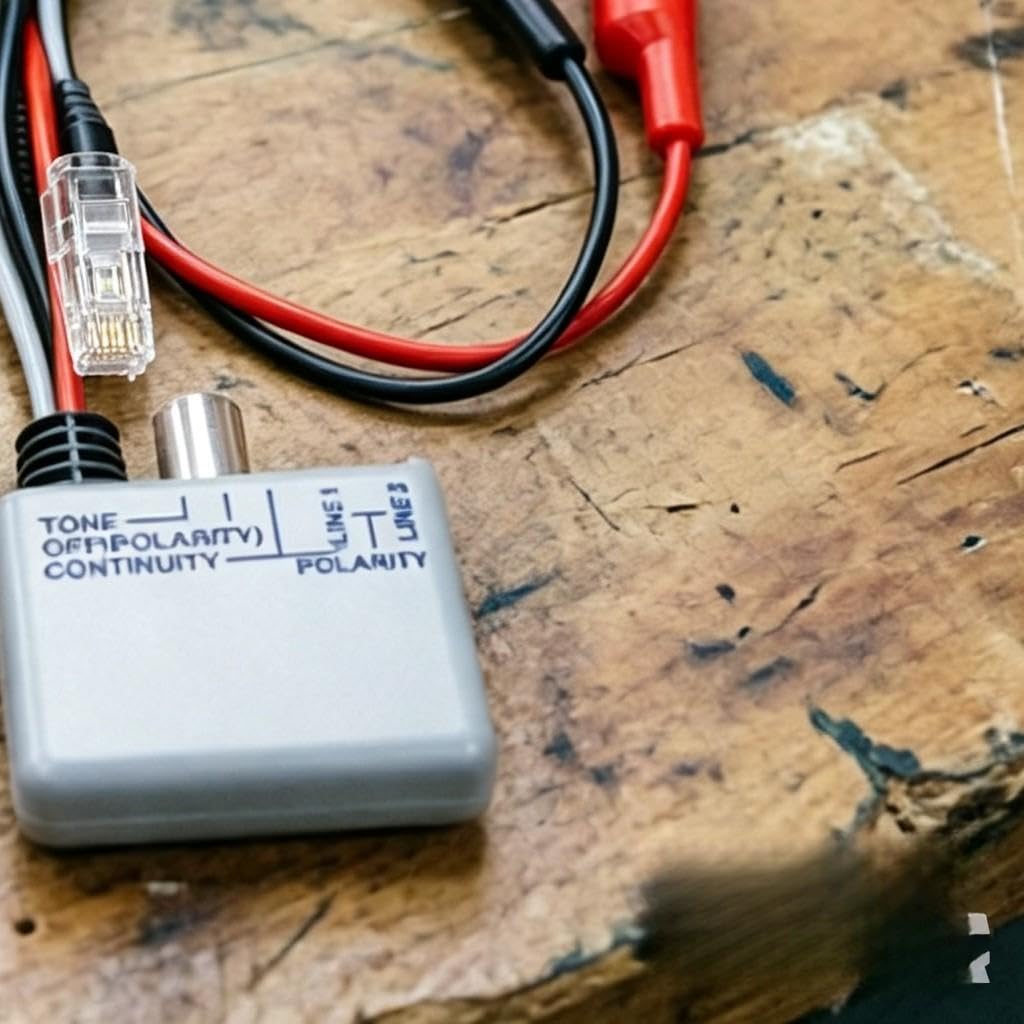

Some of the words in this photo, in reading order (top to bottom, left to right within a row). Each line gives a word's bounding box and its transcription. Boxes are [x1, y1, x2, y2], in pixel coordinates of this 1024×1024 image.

[37, 512, 118, 534] TONE
[389, 496, 418, 541] LINE
[44, 551, 219, 580] CONTINUITY
